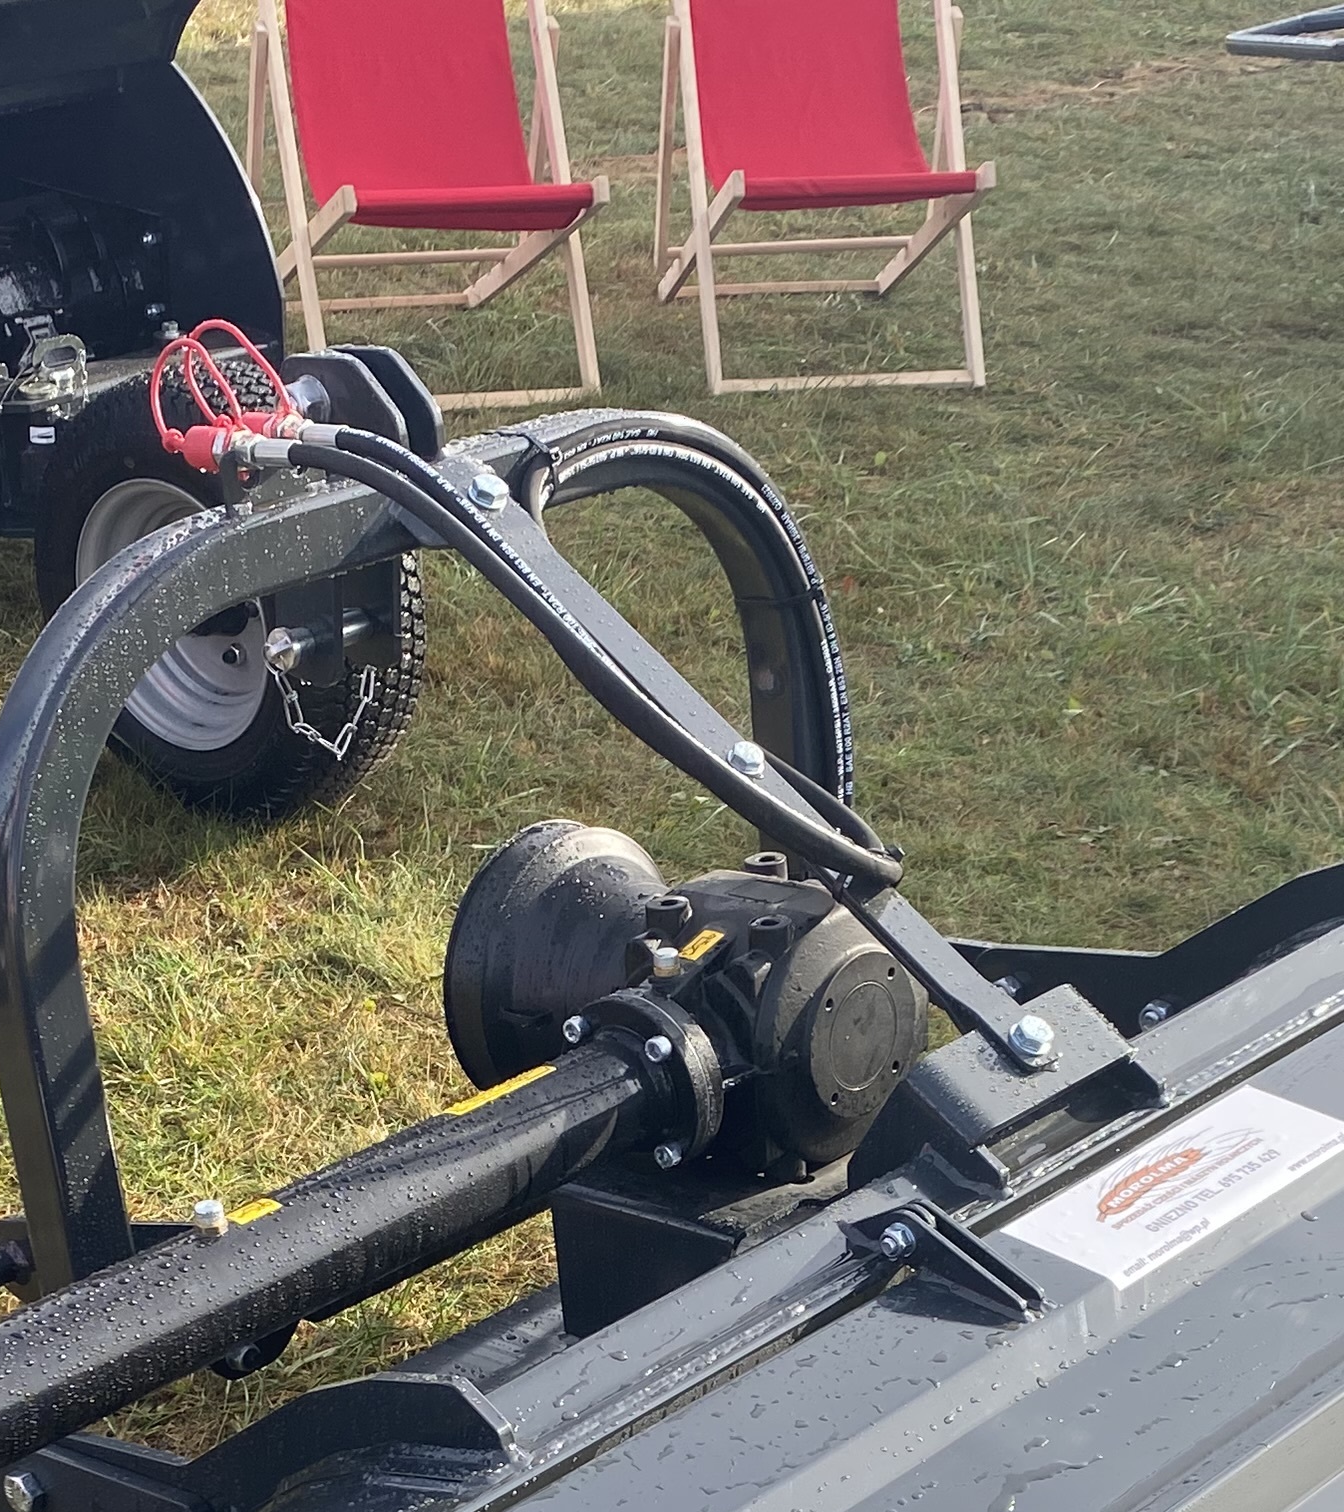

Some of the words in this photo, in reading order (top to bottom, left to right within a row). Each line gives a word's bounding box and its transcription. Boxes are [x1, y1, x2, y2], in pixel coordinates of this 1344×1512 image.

[1108, 1156, 1189, 1208] MOROLMA
[1145, 1200, 1199, 1233] GNIEZNO
[1122, 1256, 1149, 1278] email:
